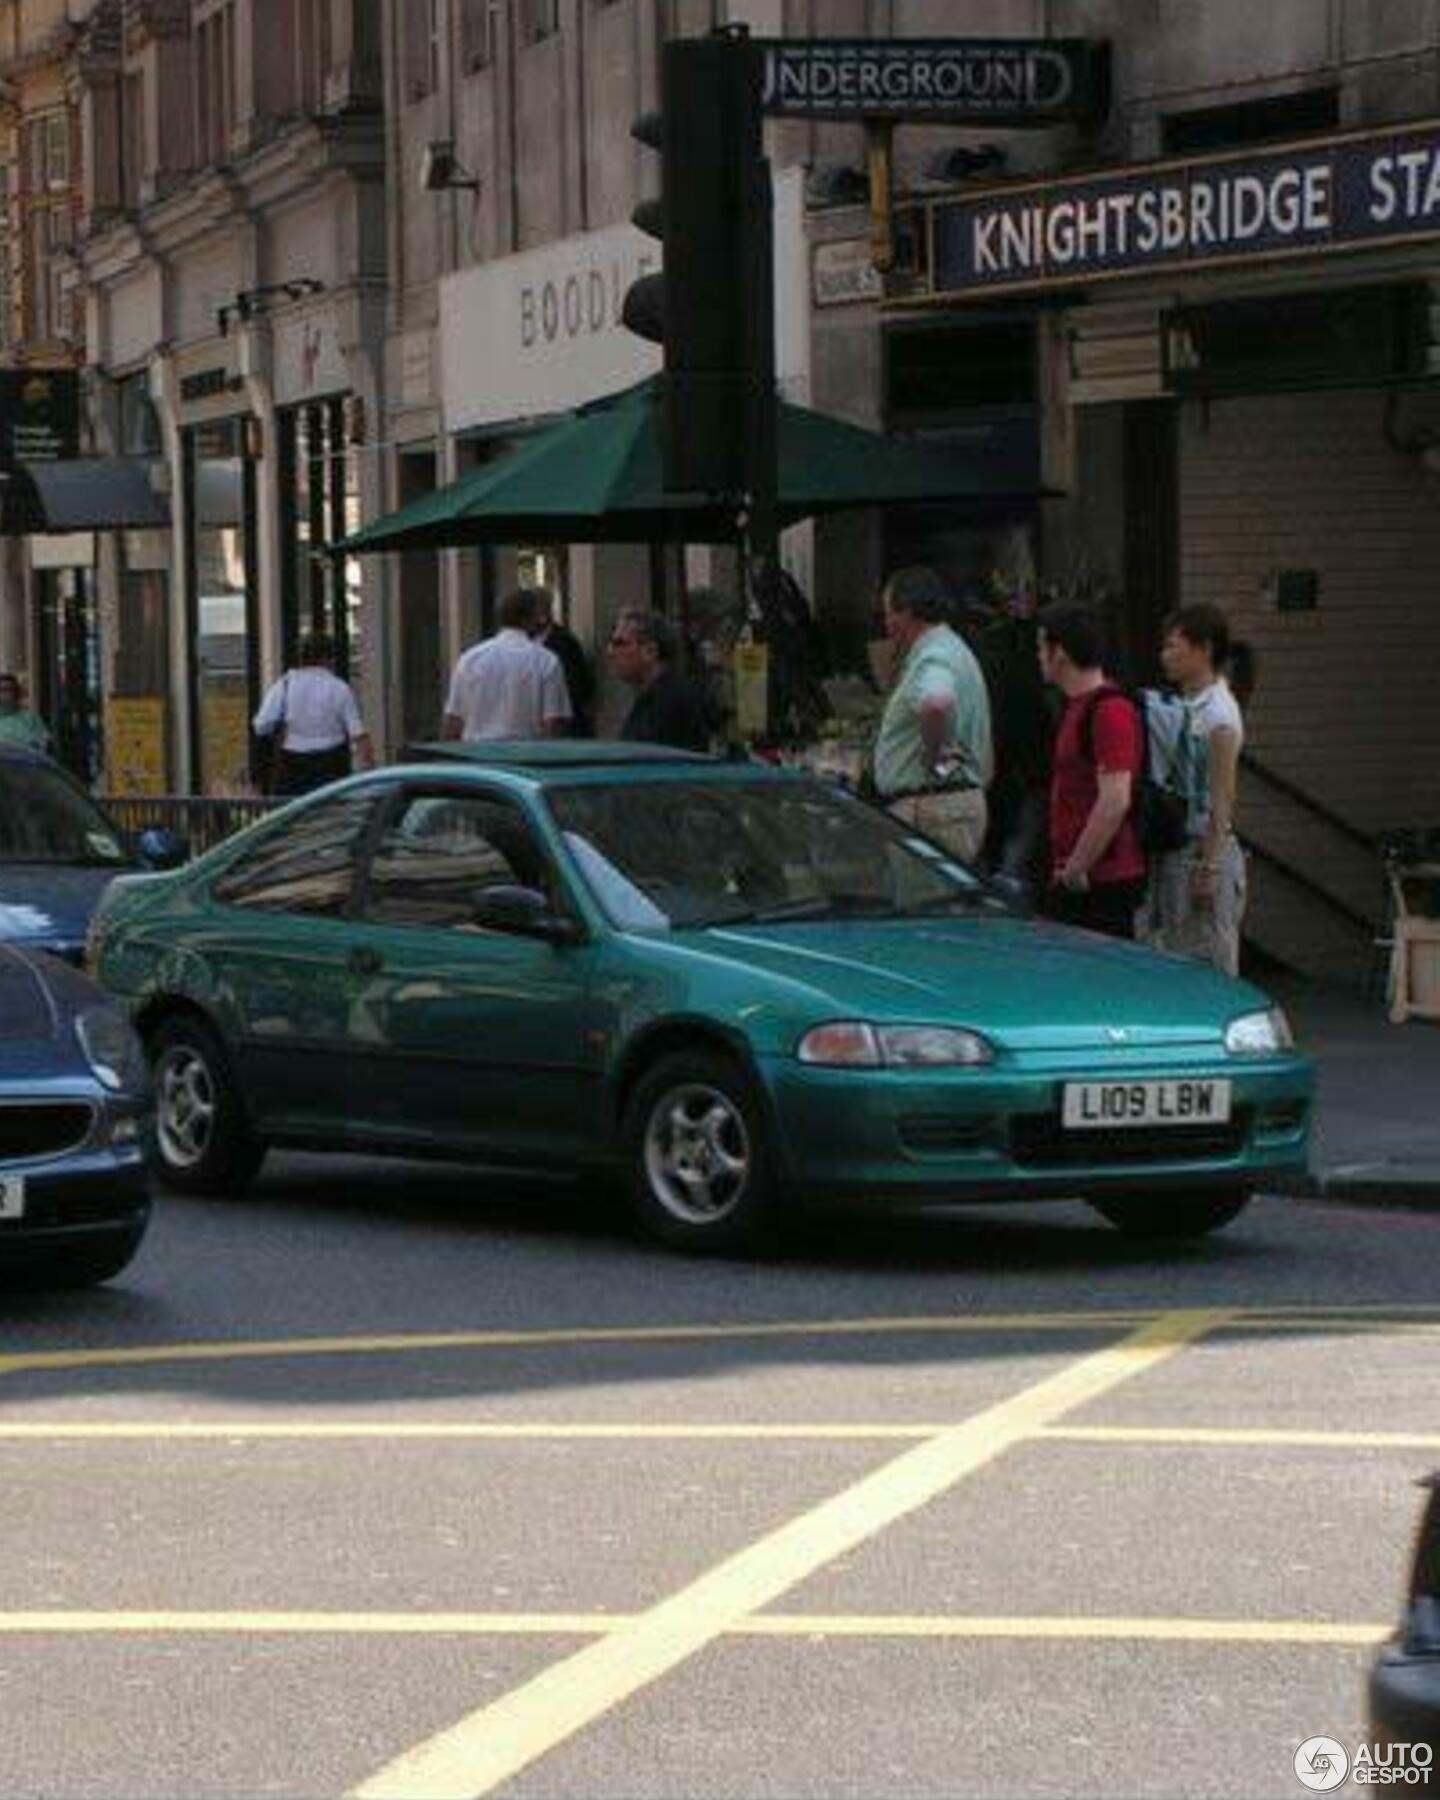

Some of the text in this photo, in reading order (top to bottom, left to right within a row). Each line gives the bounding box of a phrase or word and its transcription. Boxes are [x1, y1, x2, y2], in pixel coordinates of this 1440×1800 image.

[974, 165, 1332, 273] KNIGHTSBRIDGE
[521, 254, 654, 347] BOODL
[1158, 1083, 1215, 1117] LBW
